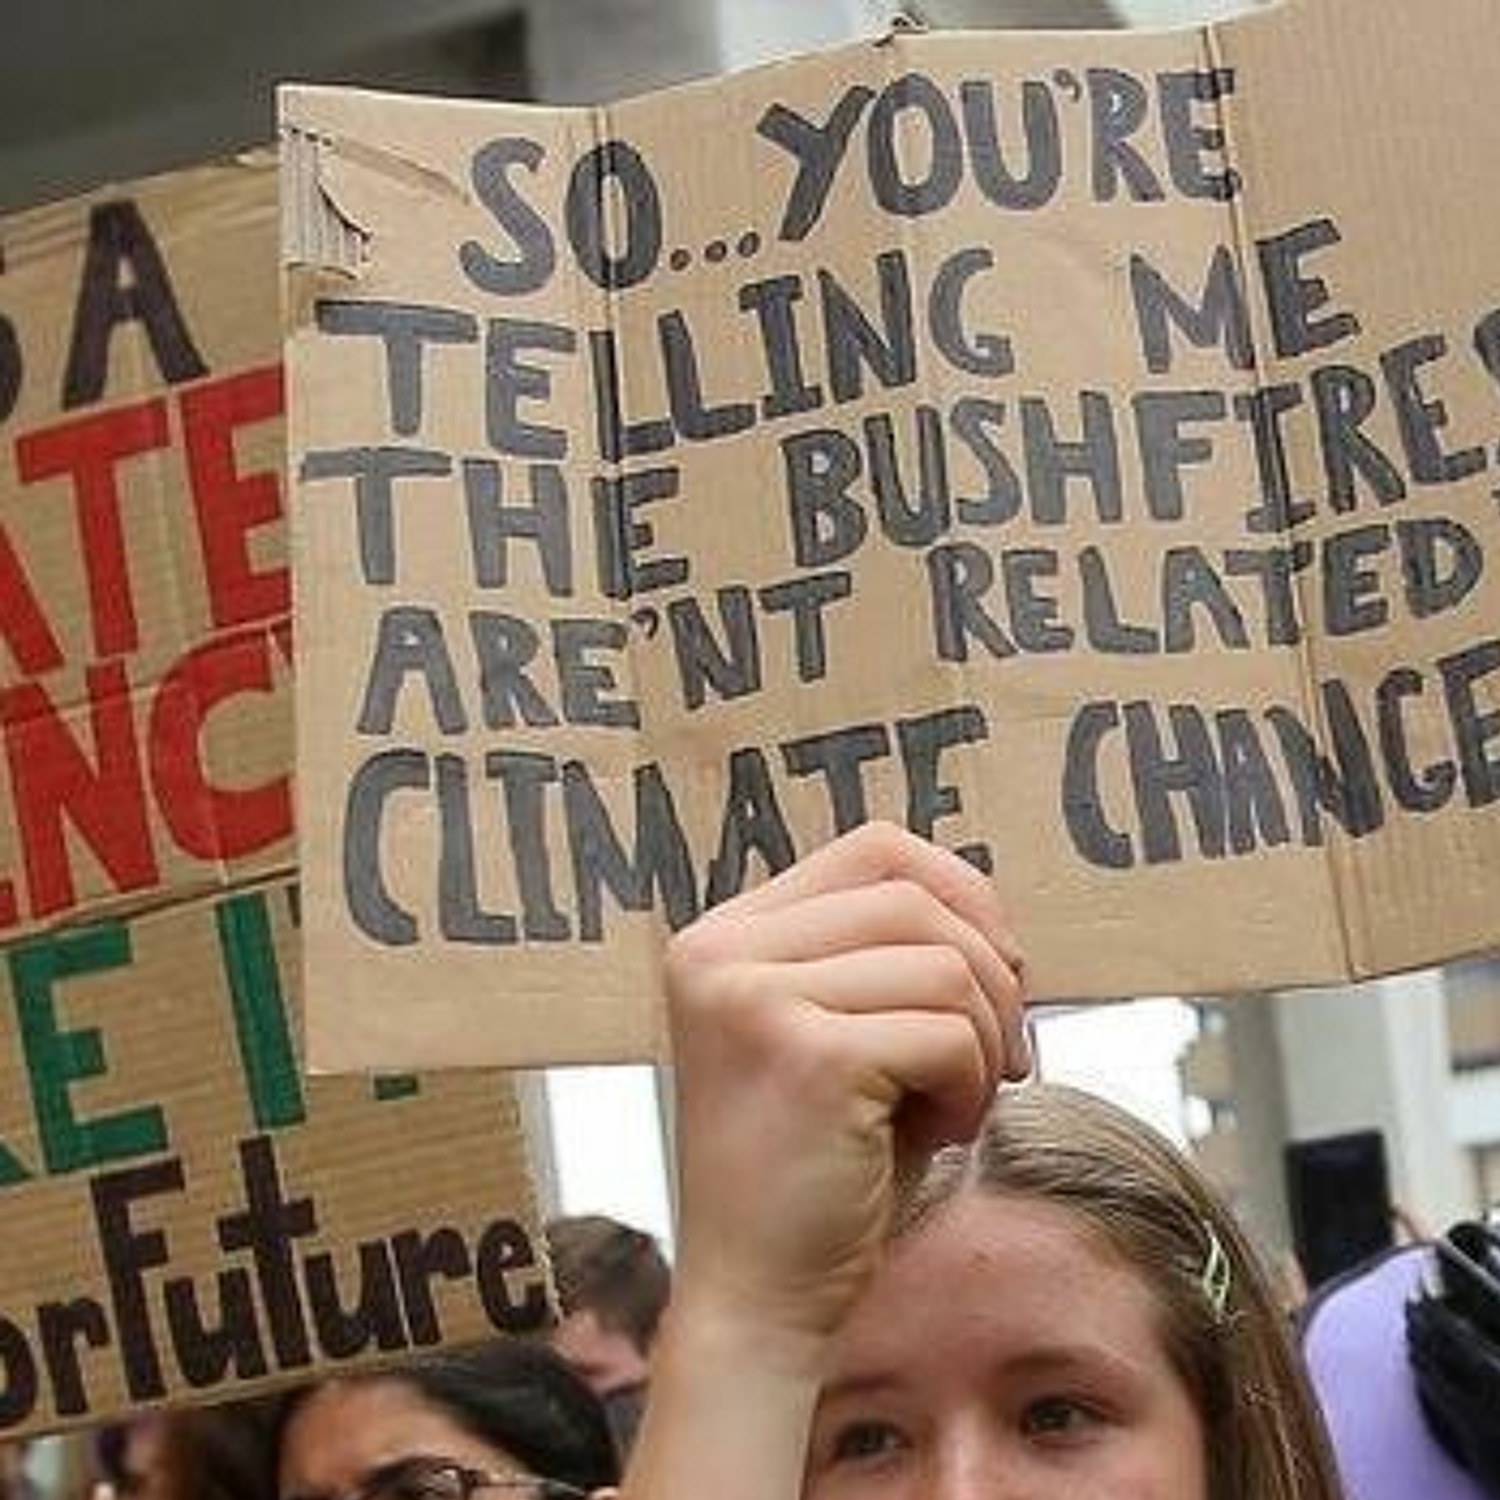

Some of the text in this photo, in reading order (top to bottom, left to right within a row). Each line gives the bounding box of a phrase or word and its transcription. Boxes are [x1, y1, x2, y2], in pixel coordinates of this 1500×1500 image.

[63, 200, 210, 411] A
[313, 218, 1361, 464] TELLING ME
[0, 364, 293, 676] TE
[299, 446, 690, 600] THE
[356, 571, 852, 735] ARE'NT
[925, 517, 1484, 663] RELATED
[343, 705, 993, 946] CLIMATE
[0, 920, 168, 1187] E
